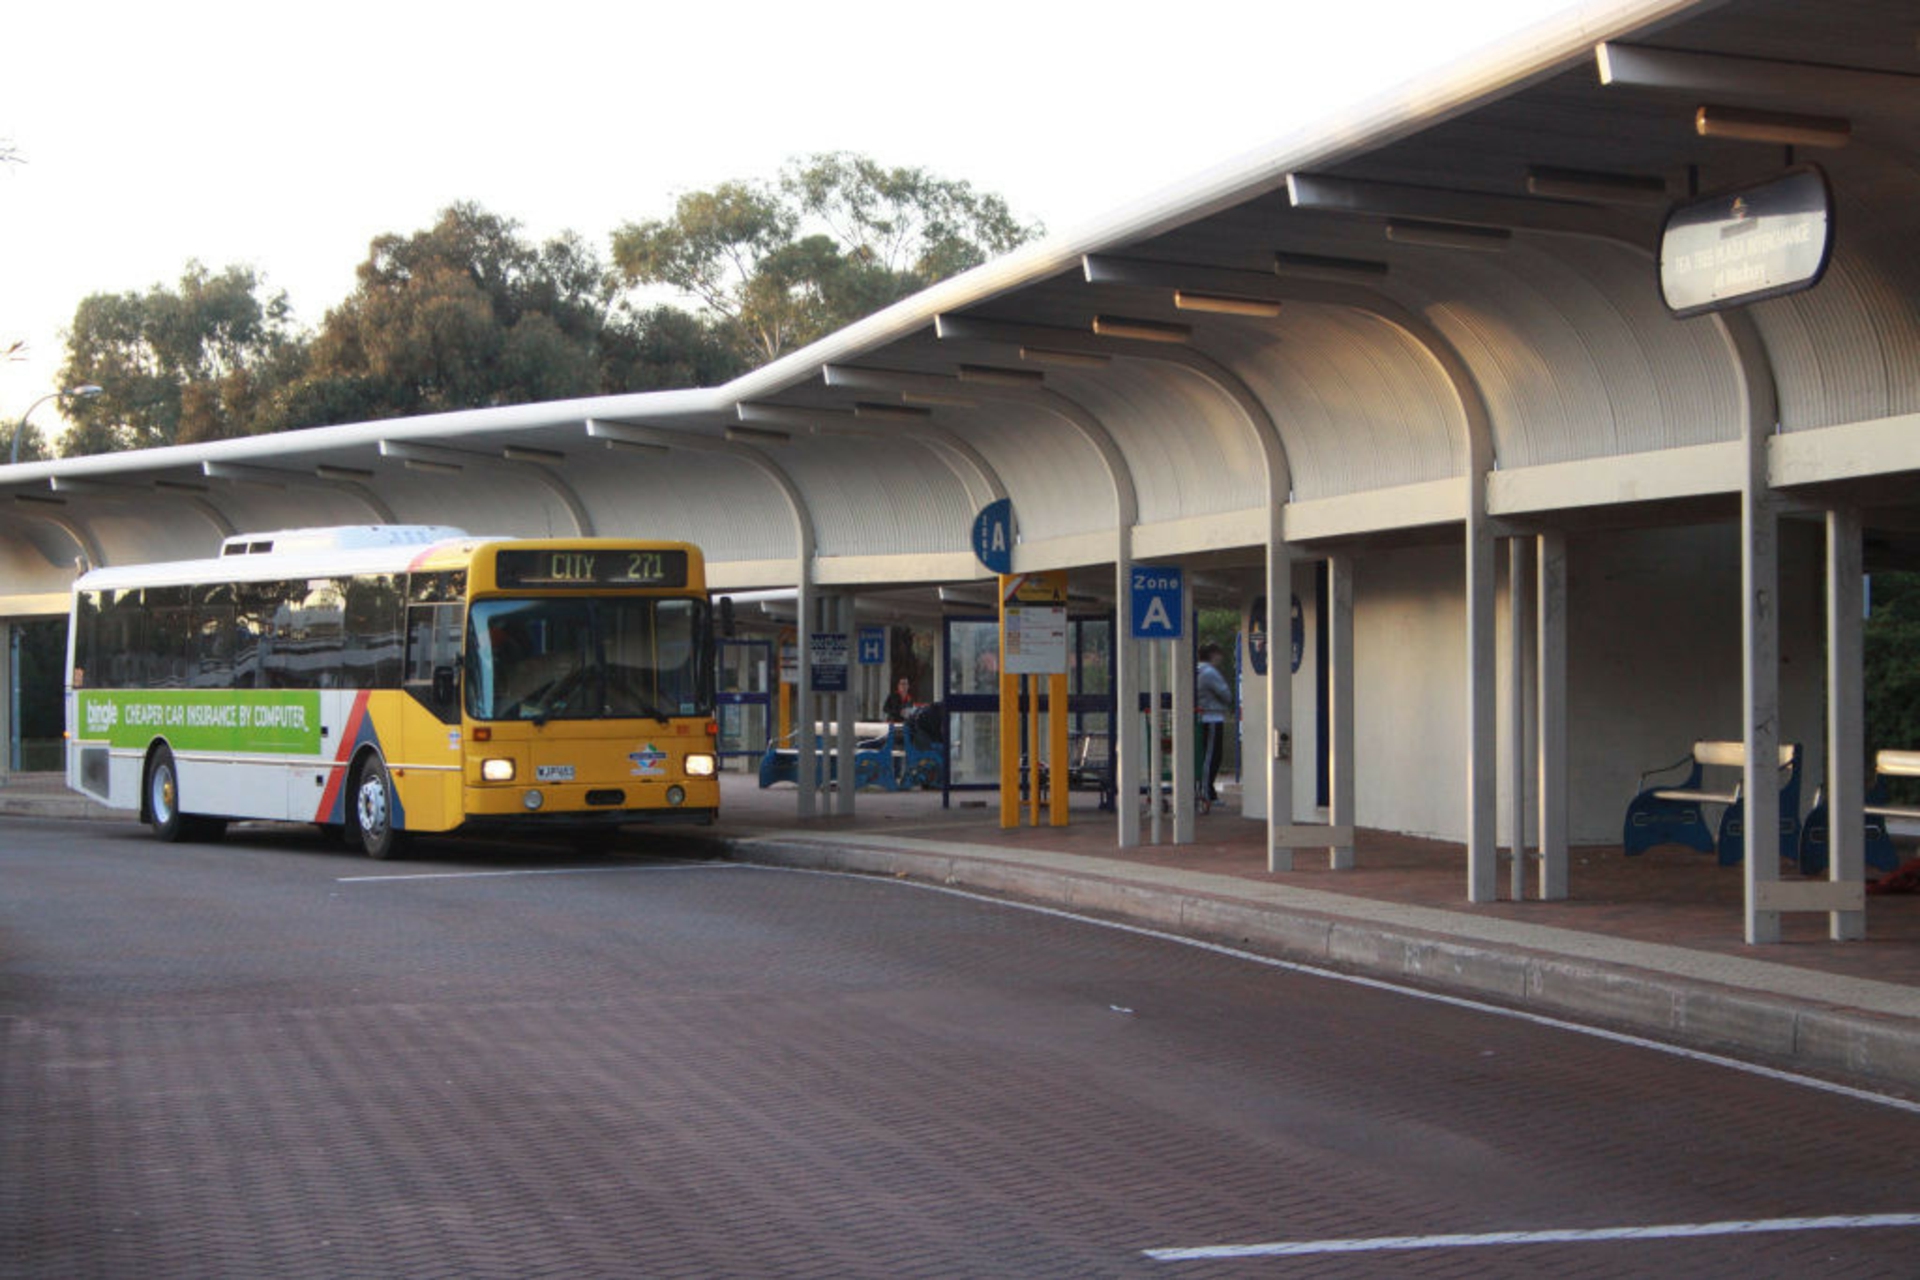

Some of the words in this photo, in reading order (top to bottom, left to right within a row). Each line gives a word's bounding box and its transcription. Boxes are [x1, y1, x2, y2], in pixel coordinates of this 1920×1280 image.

[991, 521, 1005, 552] A
[552, 554, 595, 579] CITY
[627, 554, 664, 578] 271
[1133, 575, 1179, 590] Zone
[1140, 596, 1172, 629] A
[864, 641, 879, 660] H
[86, 698, 118, 731] bingle
[124, 704, 163, 725] CHEAPER
[165, 704, 184, 726] CAR
[187, 705, 236, 727] INSURANCE
[240, 705, 251, 727] BY
